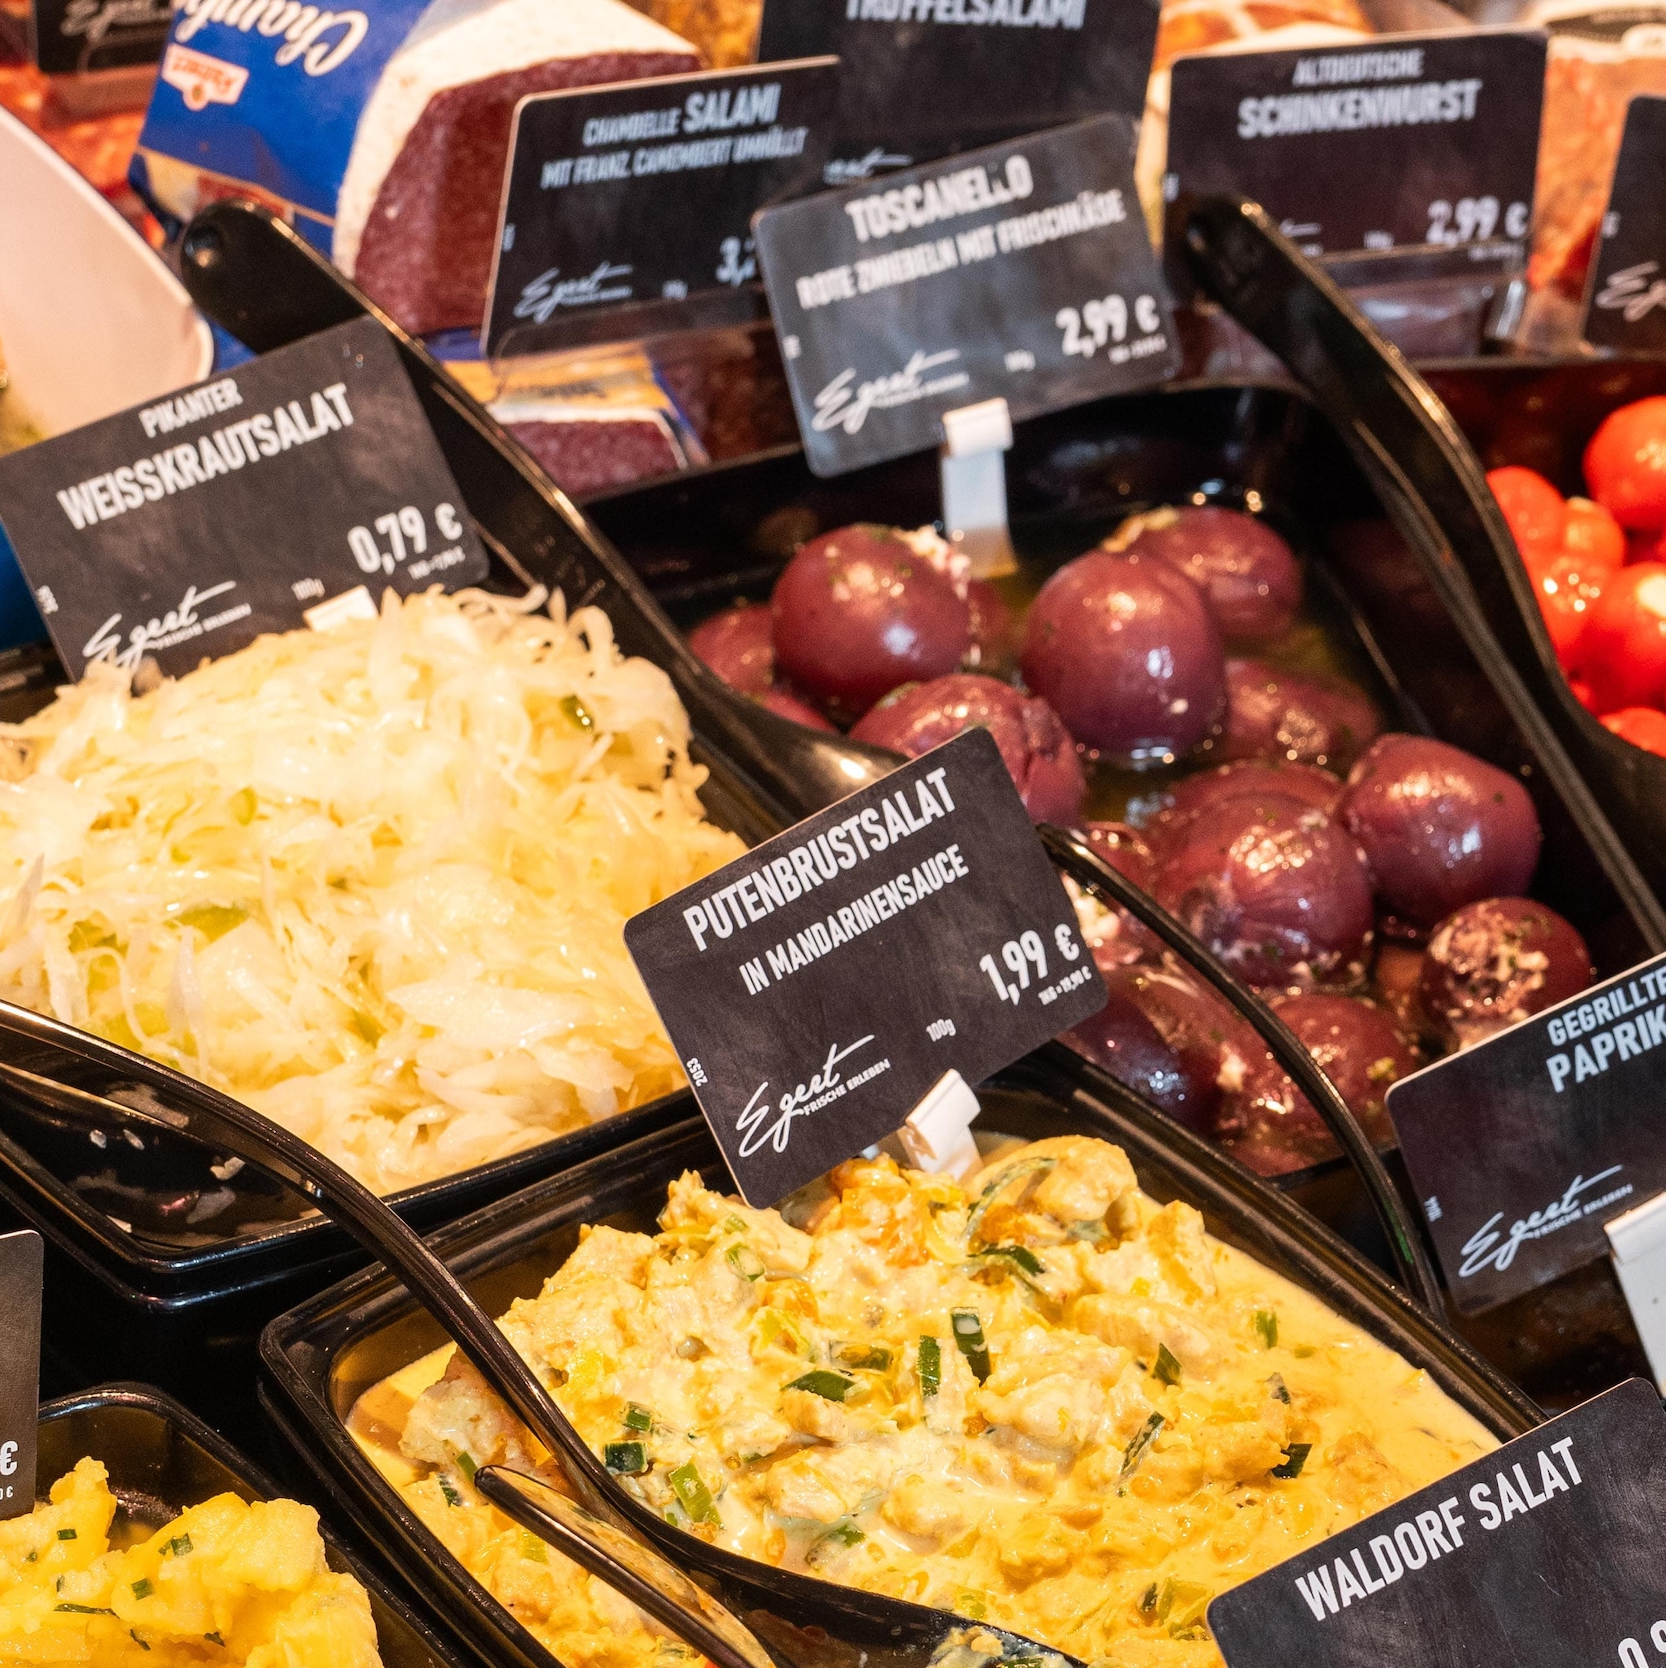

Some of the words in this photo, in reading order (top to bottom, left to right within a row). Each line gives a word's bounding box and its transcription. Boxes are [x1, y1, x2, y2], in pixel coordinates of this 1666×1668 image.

[683, 84, 780, 133] SALAMI
[1055, 294, 1128, 358] 2,99
[1135, 295, 1159, 332] €
[139, 378, 243, 438] PIKANTER
[56, 382, 354, 530] WEISSKRAUTSALAT
[347, 505, 426, 575] 0,79
[435, 503, 463, 540] €
[682, 767, 955, 952] PUTENBRUSTSALAT
[739, 957, 770, 995] IN
[765, 843, 969, 980] MANDARINENSAUCE
[979, 930, 1048, 1006] 1,99
[1054, 924, 1080, 961] €
[925, 1016, 957, 1045] 100g
[686, 1057, 708, 1087] 2053
[802, 1083, 847, 1116] FRISCHE
[845, 1057, 891, 1091] ERLEBEN
[5, 1486, 14, 1498] €
[1294, 1496, 1465, 1622] WALDORF
[1469, 1436, 1582, 1530] SALAT
